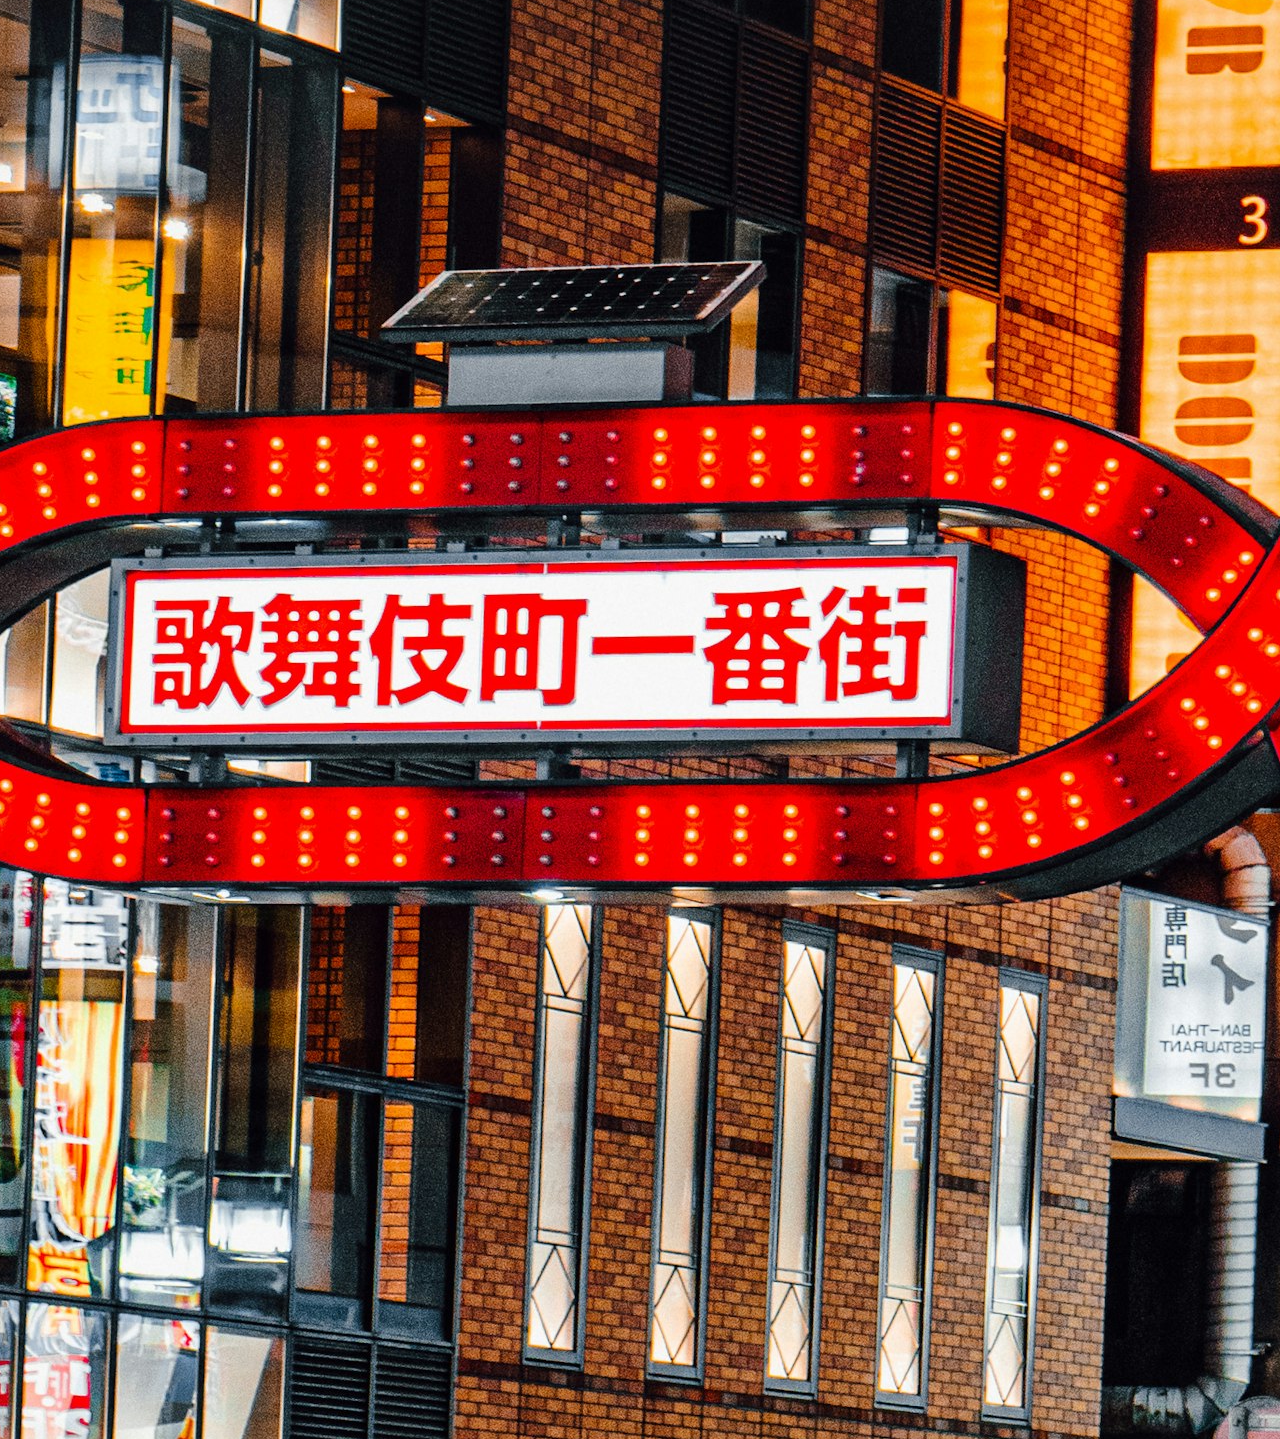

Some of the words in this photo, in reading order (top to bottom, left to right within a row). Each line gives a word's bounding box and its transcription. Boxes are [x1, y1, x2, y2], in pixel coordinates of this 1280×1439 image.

[1238, 196, 1269, 244] 3
[152, 588, 926, 709] 歌舞伎町一番街
